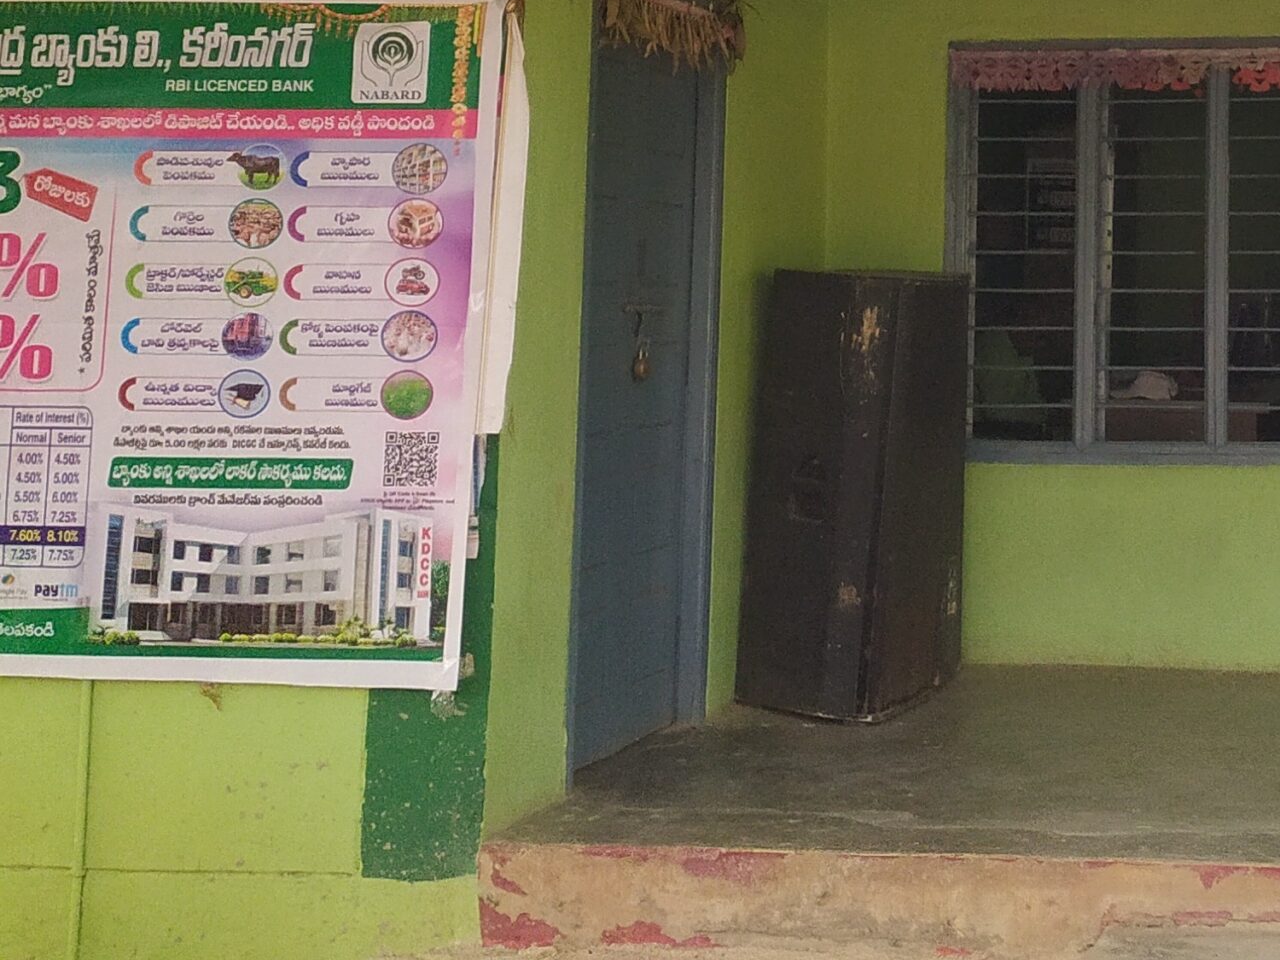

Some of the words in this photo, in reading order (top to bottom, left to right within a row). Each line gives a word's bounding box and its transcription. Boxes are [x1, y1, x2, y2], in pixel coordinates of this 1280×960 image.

[31, 26, 128, 86] బ్యాంకు
[180, 23, 316, 68] కరీంనగర్
[165, 80, 190, 92] RBI
[194, 80, 268, 92] LICENCED
[272, 80, 314, 92] BANK
[359, 90, 422, 100] NABARD
[8, 113, 40, 130] మన
[42, 114, 94, 136] బ్యాంకు
[33, 174, 91, 209] రోజులకు
[83, 280, 98, 313] కాలం
[16, 412, 33, 422] Rate
[35, 412, 43, 422] of
[45, 412, 74, 423] Interest
[16, 432, 47, 443] Normal
[57, 433, 86, 444] Senior
[112, 463, 151, 486] బ్యాంకు
